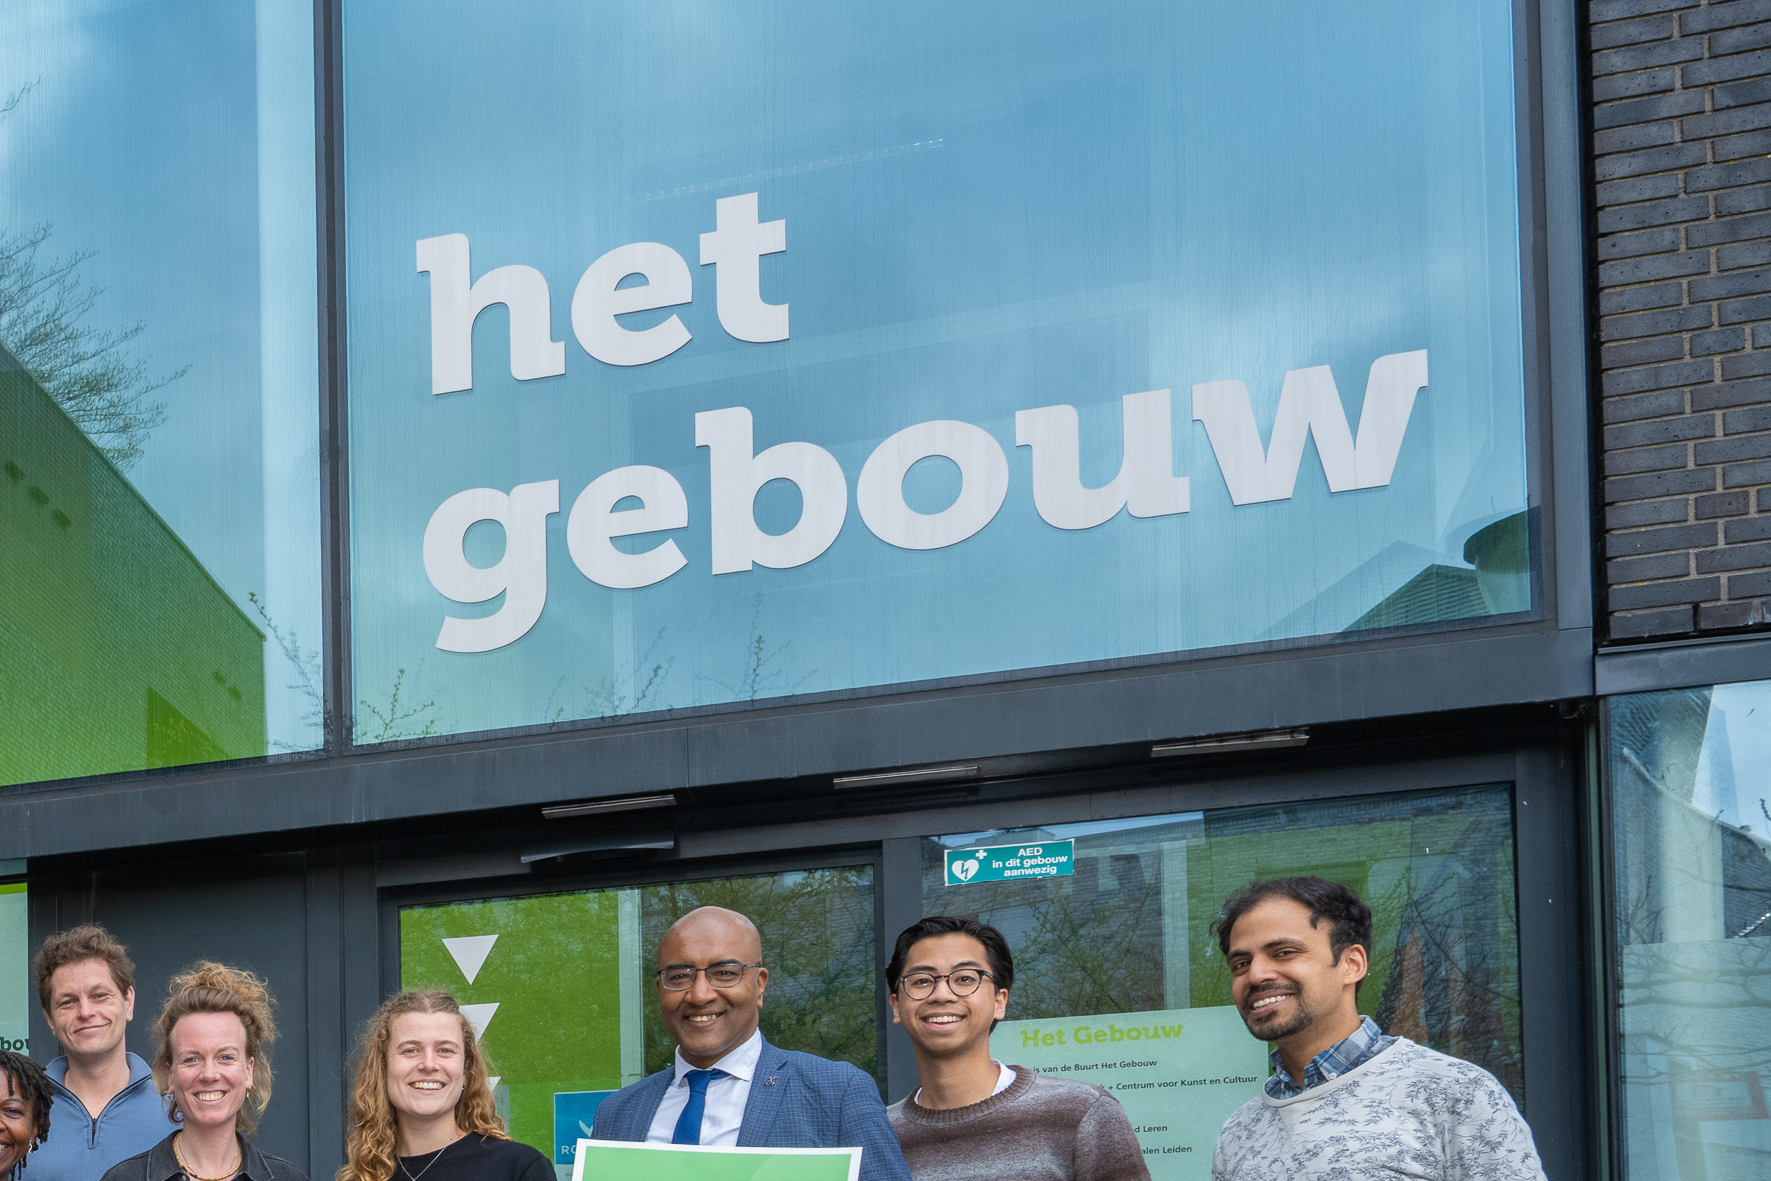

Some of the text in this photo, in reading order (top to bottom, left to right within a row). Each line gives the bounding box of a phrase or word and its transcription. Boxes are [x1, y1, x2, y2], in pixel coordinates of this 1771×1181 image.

[416, 191, 790, 396] het
[422, 348, 1429, 655] gebouw
[1017, 847, 1043, 857] AED
[992, 855, 1068, 868] in dit gebouw
[1004, 865, 1057, 876] aanwezig
[1021, 1024, 1183, 1048] Het Gebouw
[1061, 1064, 1071, 1072] de
[1074, 1063, 1099, 1071] Buurt
[1119, 1060, 1157, 1068] Gebouw
[1116, 1082, 1154, 1090] Centrum
[1180, 1078, 1207, 1086] Kunst
[1223, 1076, 1258, 1084] Cultuur
[1162, 1145, 1192, 1154] Leiden
